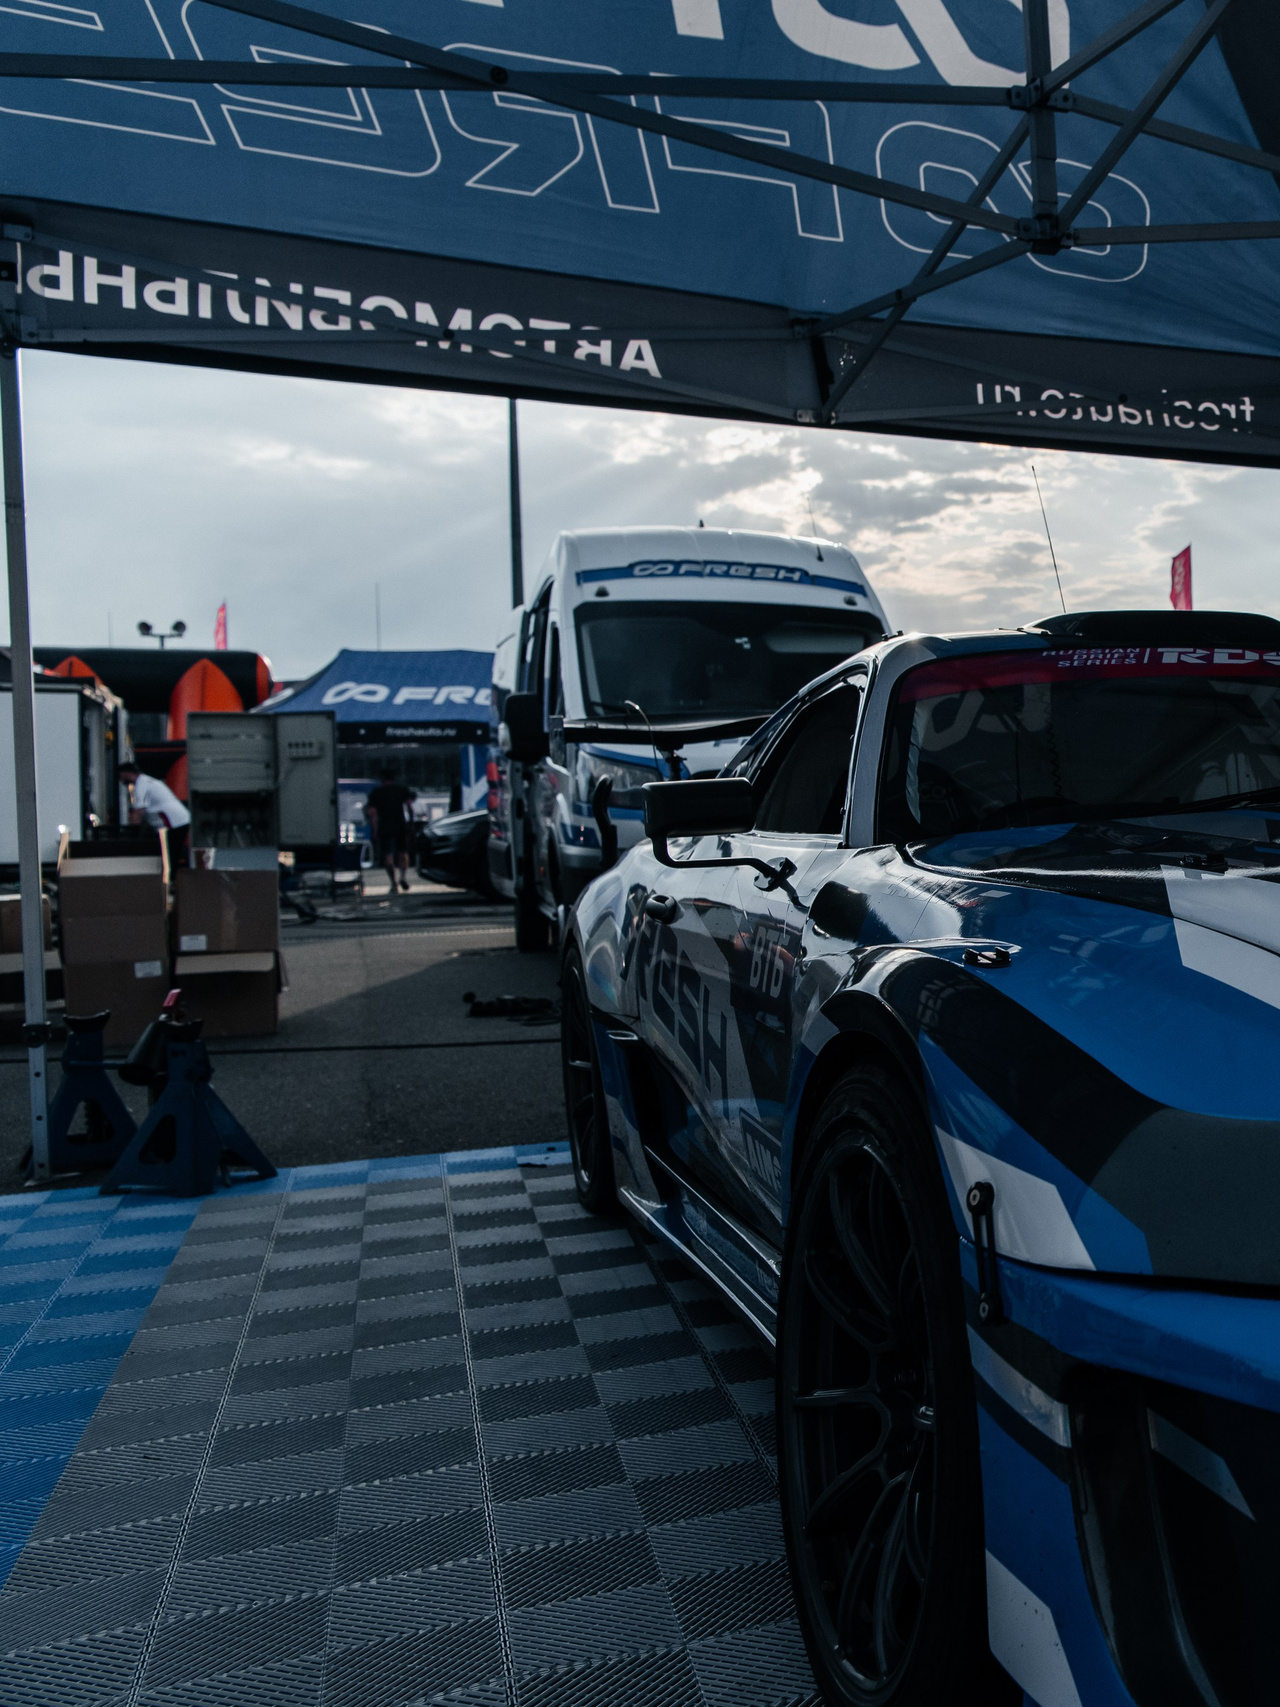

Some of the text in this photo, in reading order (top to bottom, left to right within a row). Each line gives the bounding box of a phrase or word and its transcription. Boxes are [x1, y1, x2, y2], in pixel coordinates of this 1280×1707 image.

[678, 562, 802, 582] FRESH
[1042, 647, 1140, 657] RUSSIAN
[1057, 658, 1137, 668] SERIES
